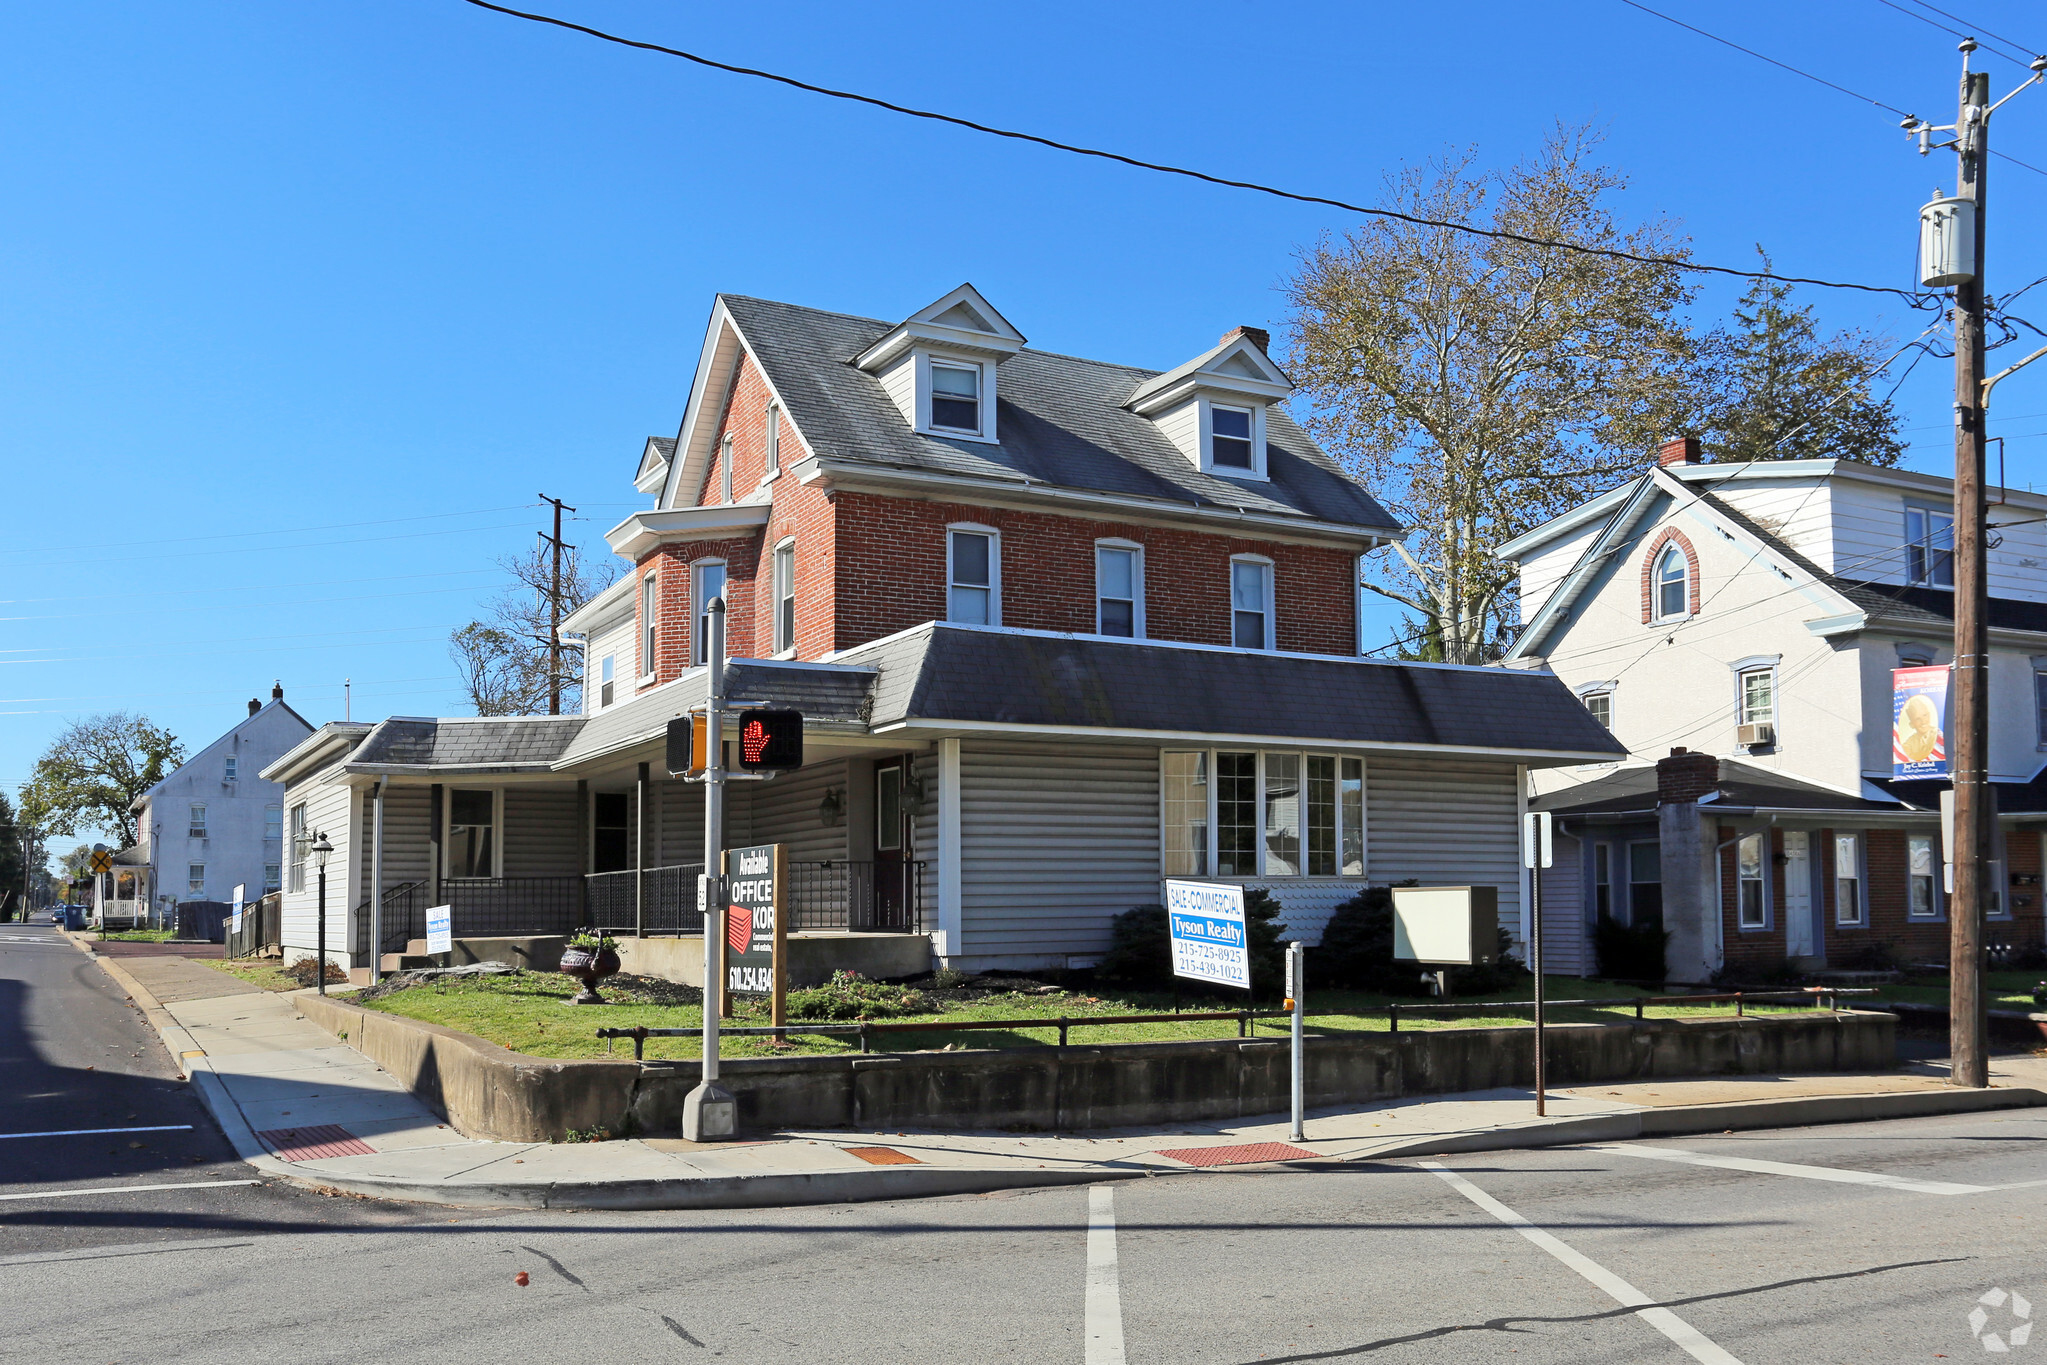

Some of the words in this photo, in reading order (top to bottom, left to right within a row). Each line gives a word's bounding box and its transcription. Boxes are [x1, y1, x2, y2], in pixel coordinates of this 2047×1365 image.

[739, 850, 768, 876] Available
[732, 880, 772, 902] OFFICE
[433, 910, 444, 920] SALE
[1173, 916, 1204, 937] Tyson
[1207, 921, 1242, 946] Realty
[1178, 942, 1241, 964] 215-725-8925
[1180, 958, 1242, 980] 215-439-1022
